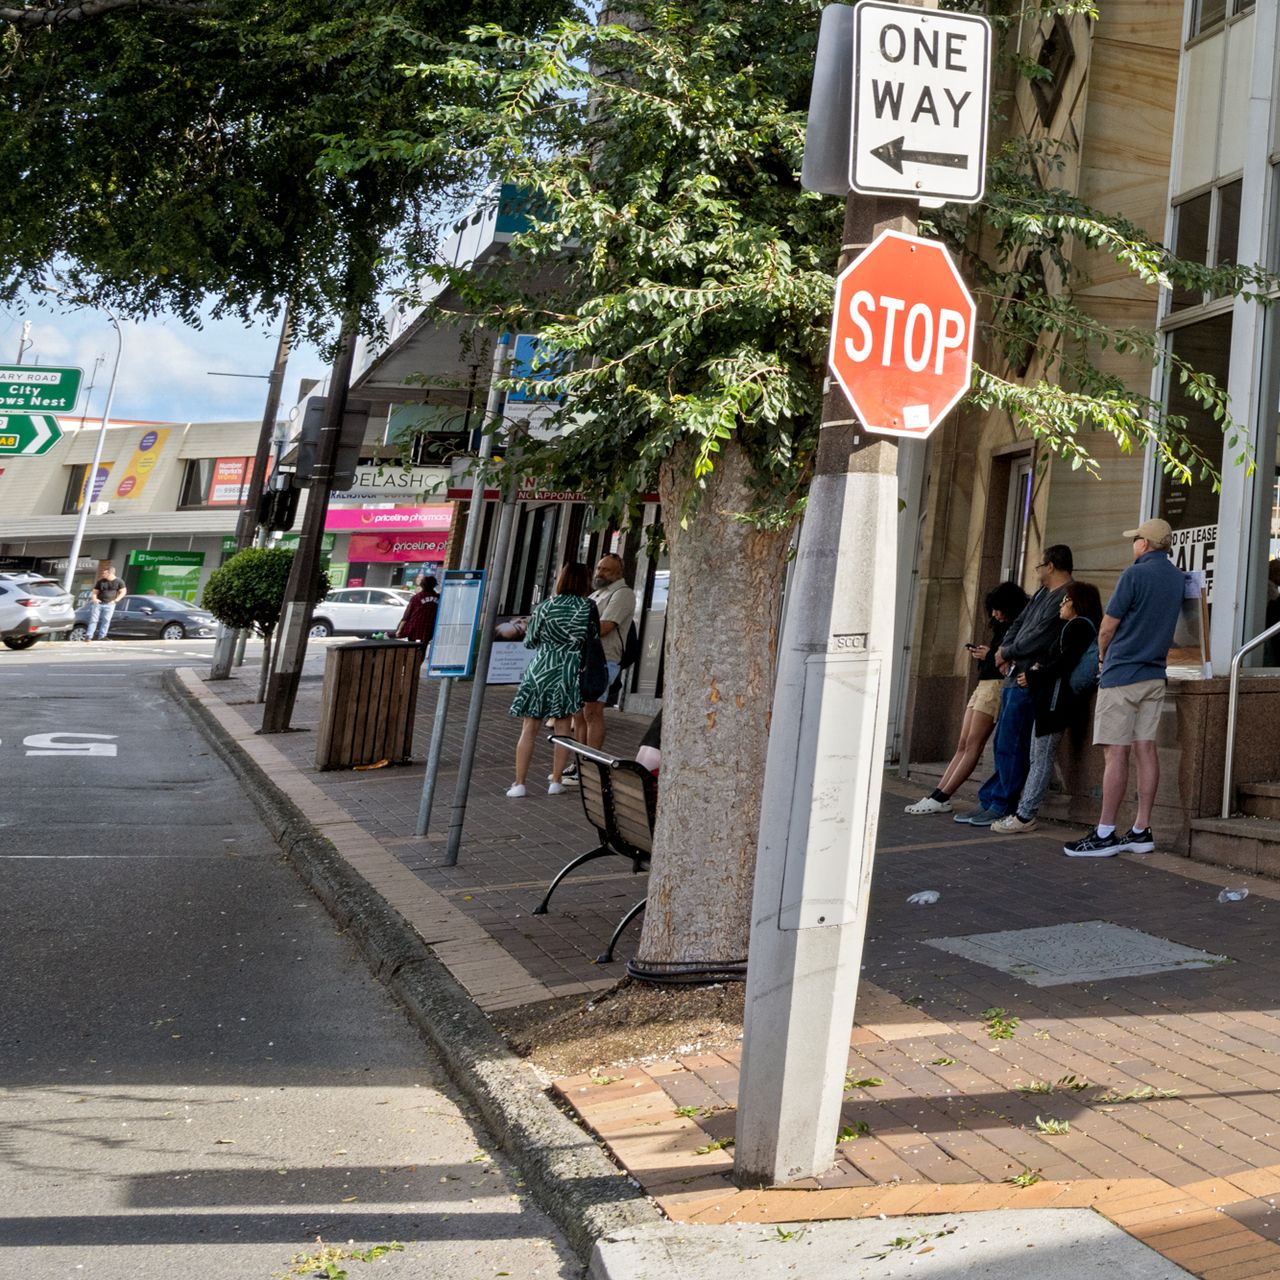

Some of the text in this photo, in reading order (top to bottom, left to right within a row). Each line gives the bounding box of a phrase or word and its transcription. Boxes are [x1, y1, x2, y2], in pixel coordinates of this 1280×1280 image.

[879, 23, 968, 73] ONE
[872, 79, 972, 128] WAY
[844, 290, 966, 376] STOP
[27, 373, 58, 382] ROAD
[9, 385, 41, 396] City
[30, 396, 66, 407] Nest
[537, 492, 586, 500] APPOINT
[374, 512, 451, 523] priceline pharmacy
[1180, 530, 1191, 545] OF
[1192, 526, 1217, 544] LEASE
[392, 541, 436, 552] priceline
